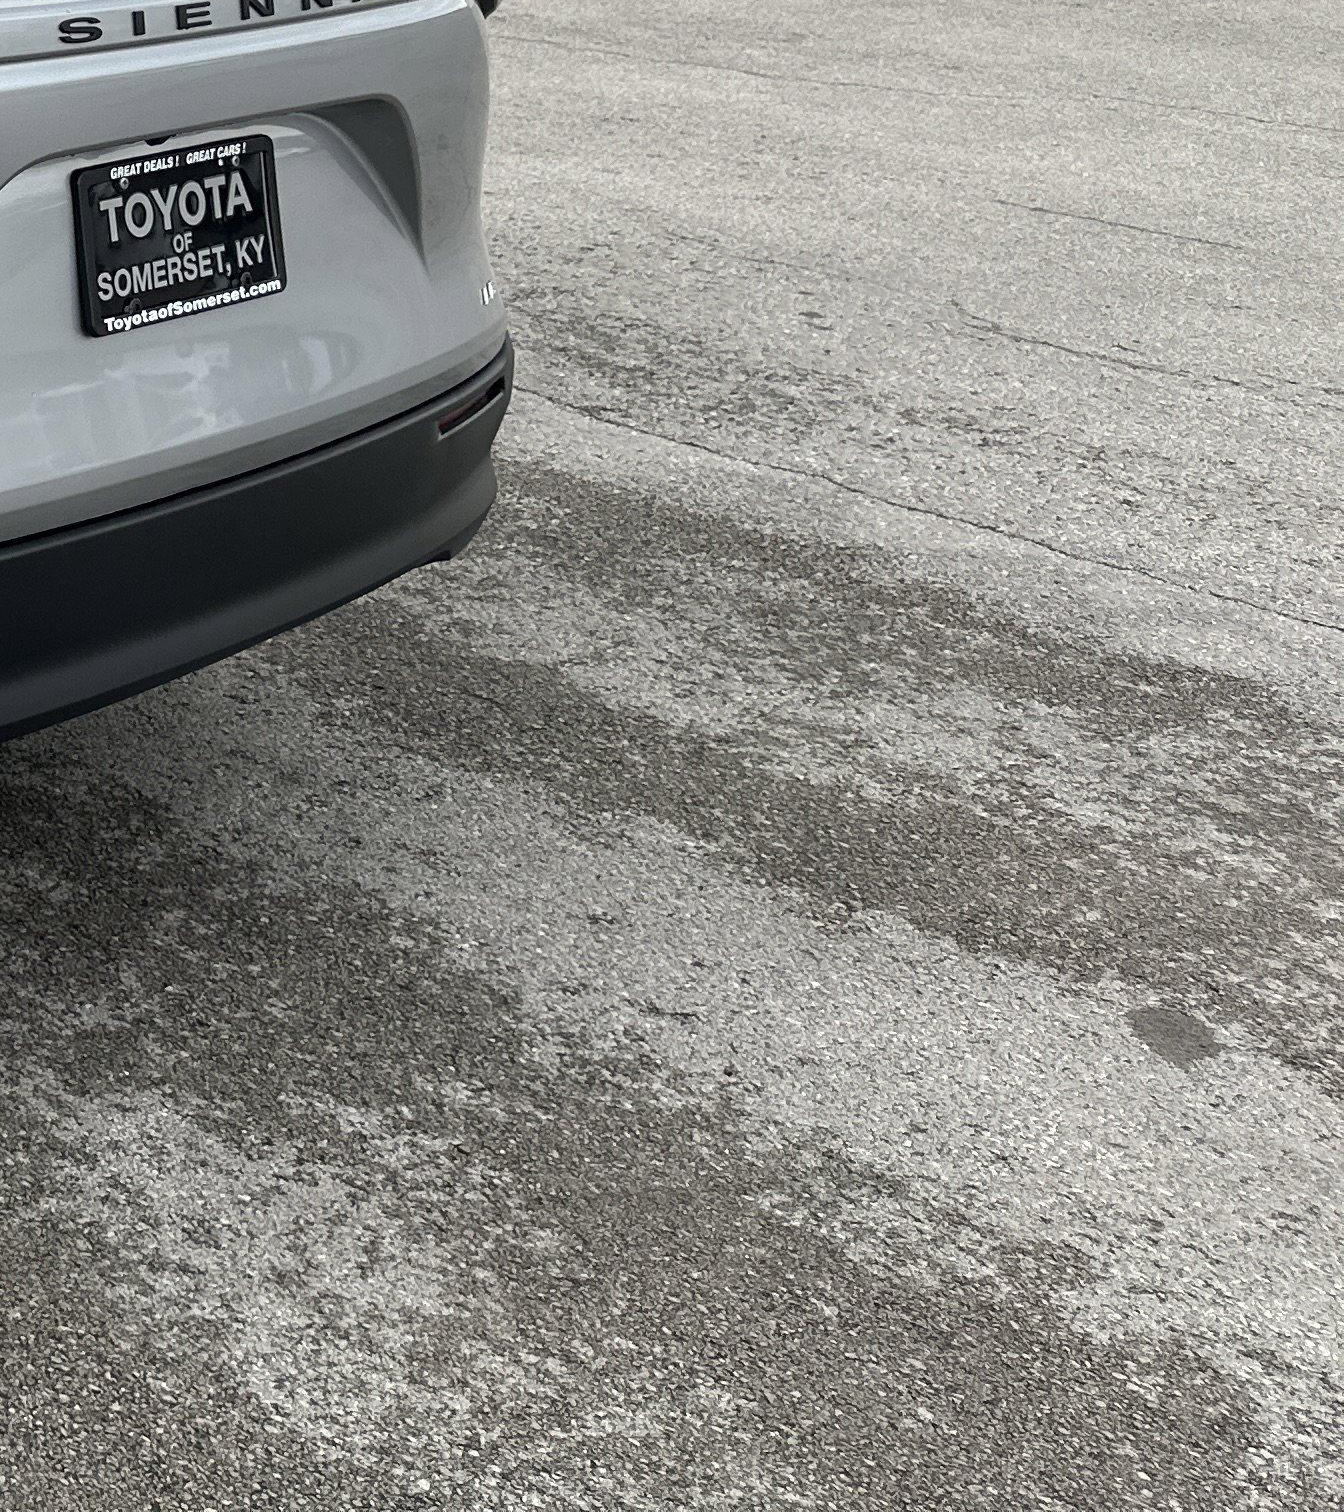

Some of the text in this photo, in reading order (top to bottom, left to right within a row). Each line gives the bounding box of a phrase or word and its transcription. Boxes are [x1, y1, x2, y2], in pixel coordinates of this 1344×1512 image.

[110, 162, 142, 180] GREAT
[185, 148, 216, 165] GREAT
[99, 170, 254, 243] TOYOTA
[97, 234, 266, 301] SOMERSET, KY
[173, 231, 193, 254] OF
[104, 279, 281, 332] ToyotaofSomerset.com
